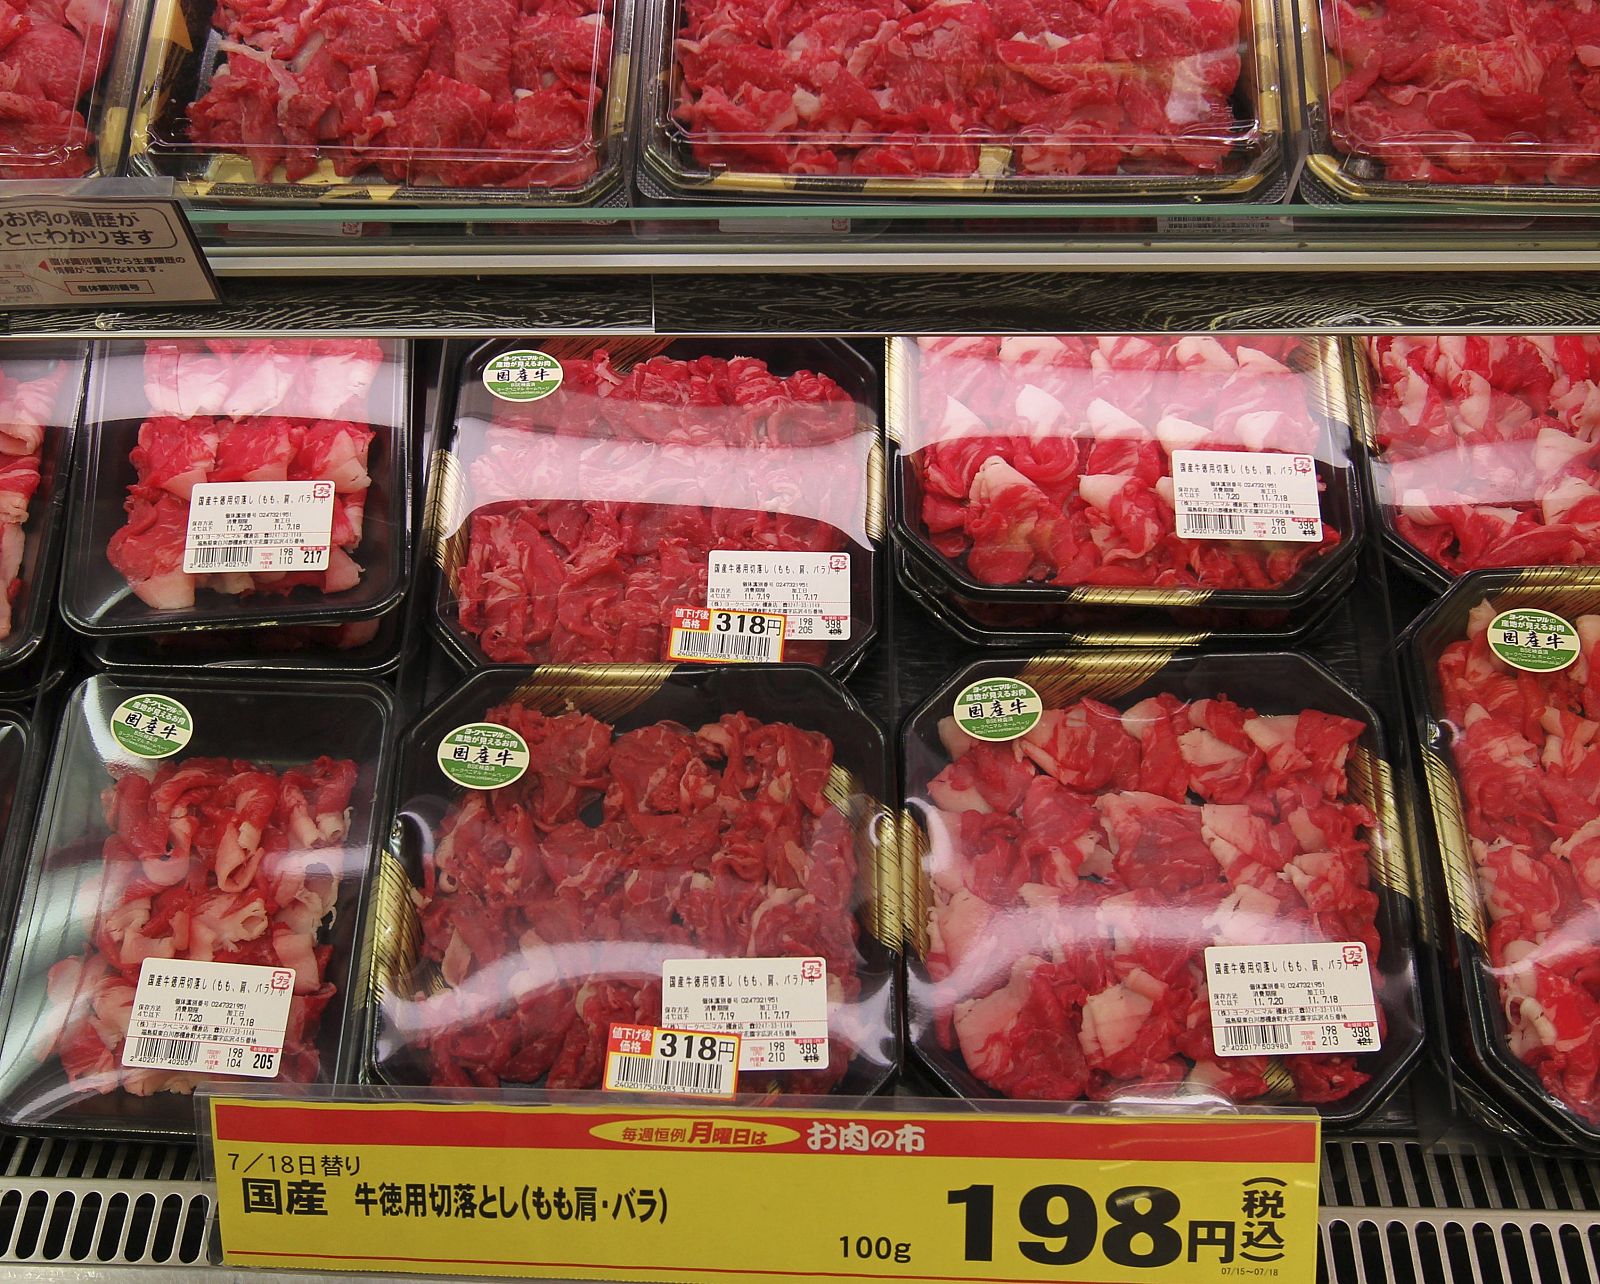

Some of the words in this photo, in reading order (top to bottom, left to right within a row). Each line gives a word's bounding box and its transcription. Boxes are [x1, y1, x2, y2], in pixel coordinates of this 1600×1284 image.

[0, 211, 140, 228] お肉の履歴が
[0, 230, 153, 245] とにわかります
[497, 368, 550, 381] 国産牛
[1298, 521, 1314, 529] 398
[280, 548, 293, 556] 198
[304, 551, 321, 563] 217
[675, 608, 709, 620] 値下げ後
[682, 619, 700, 629] 価格
[716, 613, 781, 637] 318円
[798, 618, 813, 626] 198
[798, 626, 813, 634] 205
[1504, 631, 1564, 649] 国産牛
[969, 699, 1027, 717] 国産牛
[126, 713, 177, 739] 国産牛
[453, 746, 513, 765] 国産牛
[612, 1028, 652, 1041] 値下げ後
[1322, 1026, 1337, 1035] 198
[1352, 1027, 1370, 1037] 398
[620, 1040, 641, 1052] 価格
[770, 1042, 785, 1051] 198
[1321, 1036, 1339, 1046] 213
[228, 1048, 243, 1058] 198
[660, 1033, 736, 1062] 318円
[800, 1044, 818, 1054] 398
[253, 1054, 274, 1069] 205
[768, 1052, 785, 1062] 210
[226, 1059, 241, 1068] 104
[806, 1121, 925, 1153] お肉の市
[241, 1177, 328, 1216] 国産
[947, 1183, 1236, 1268] 198円
[840, 1236, 911, 1263] 100g
